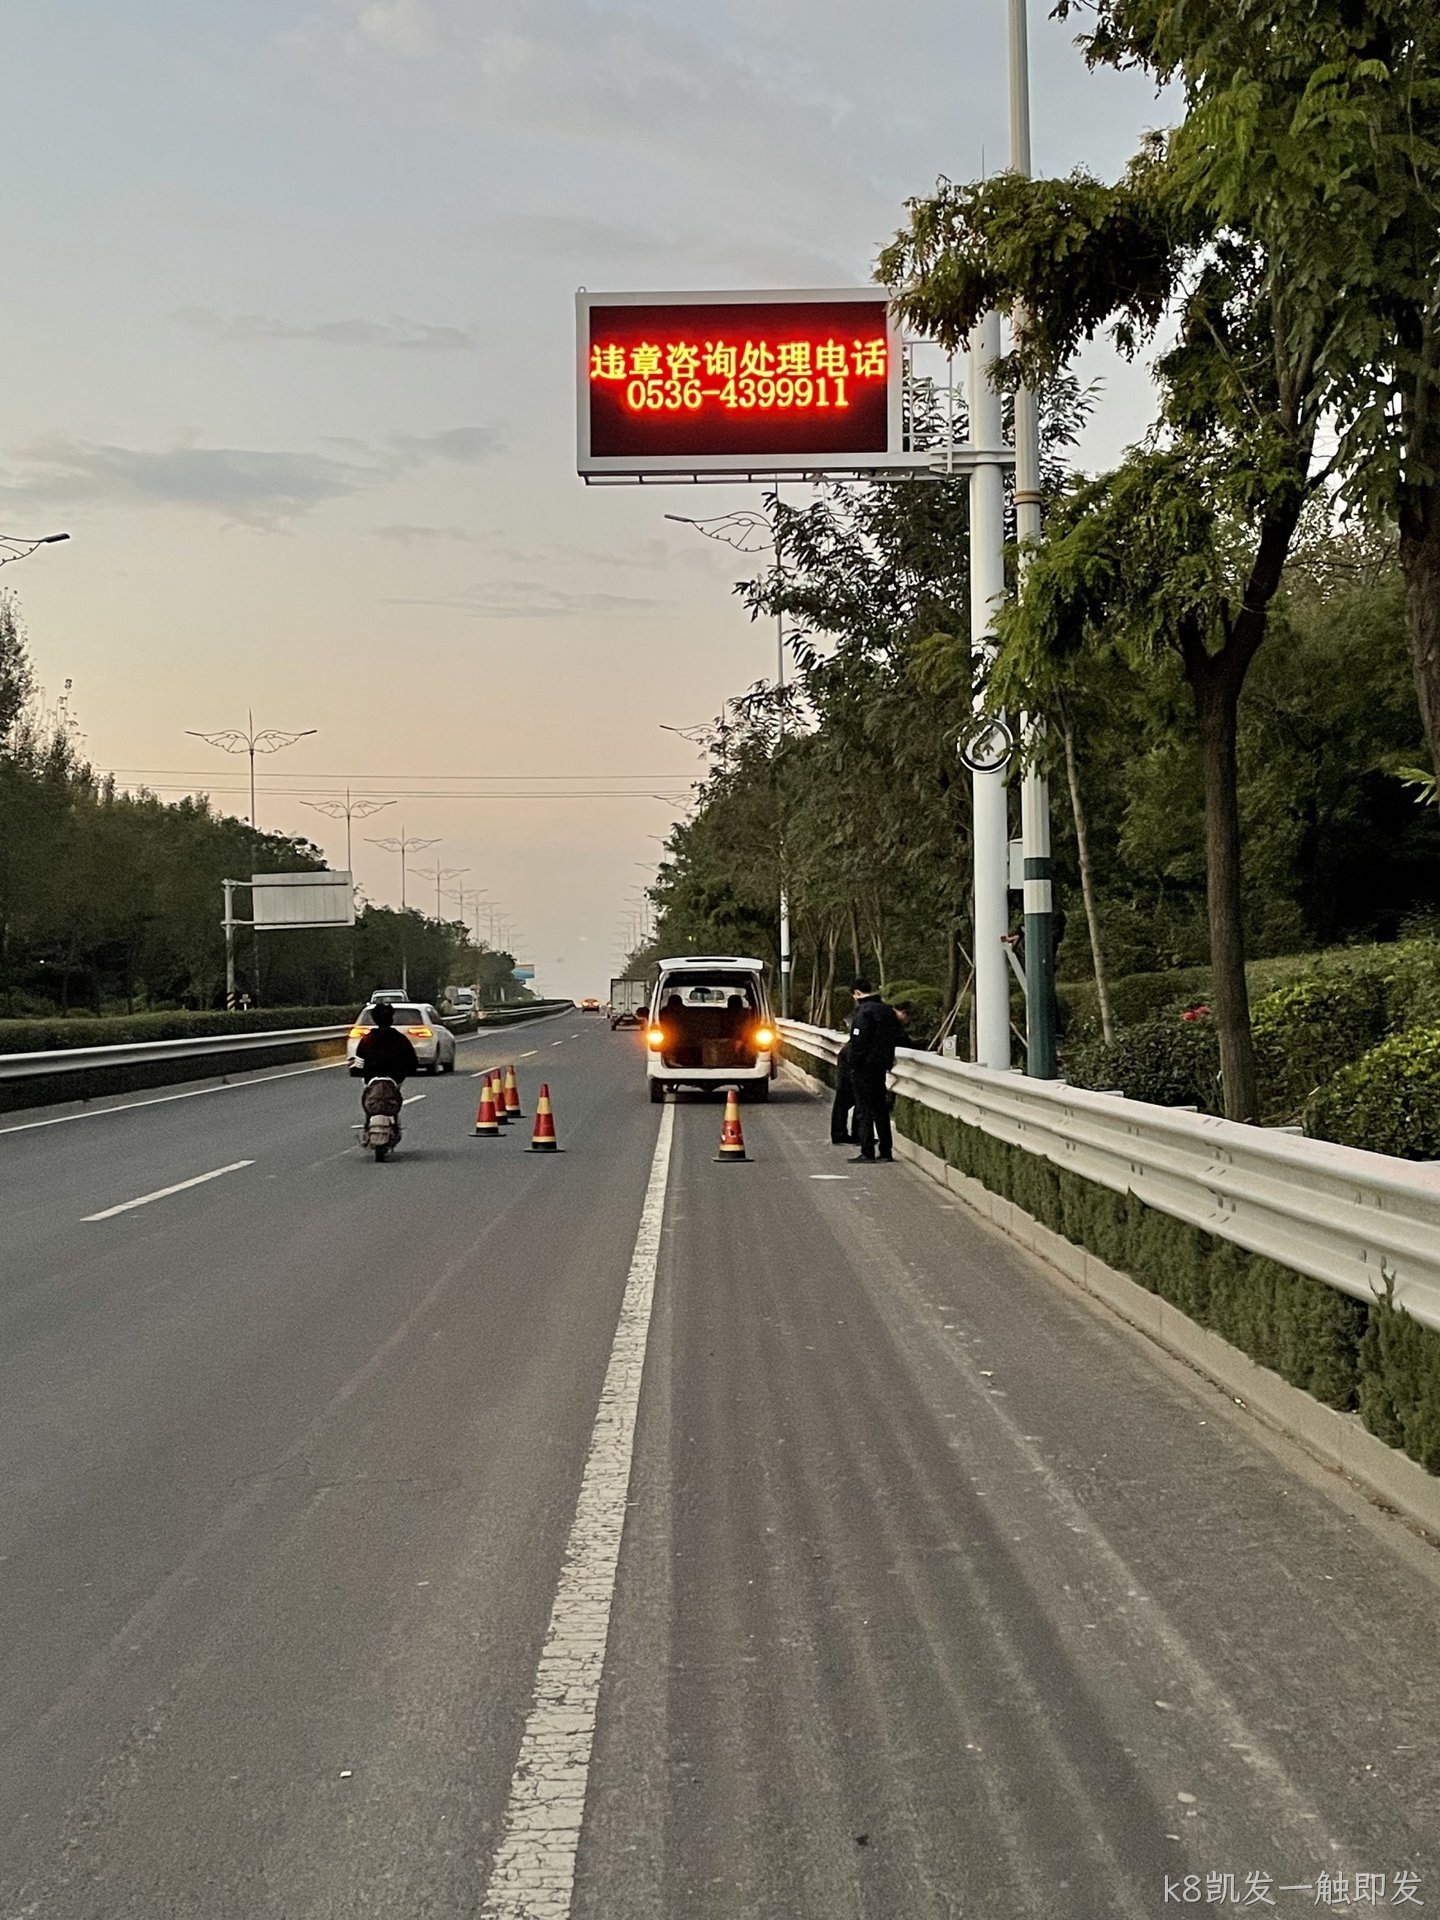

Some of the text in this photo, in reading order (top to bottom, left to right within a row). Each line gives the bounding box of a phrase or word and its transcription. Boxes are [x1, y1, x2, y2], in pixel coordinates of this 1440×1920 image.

[590, 338, 887, 380] 违章咨询处理电话
[627, 376, 849, 409] 0536-4399911
